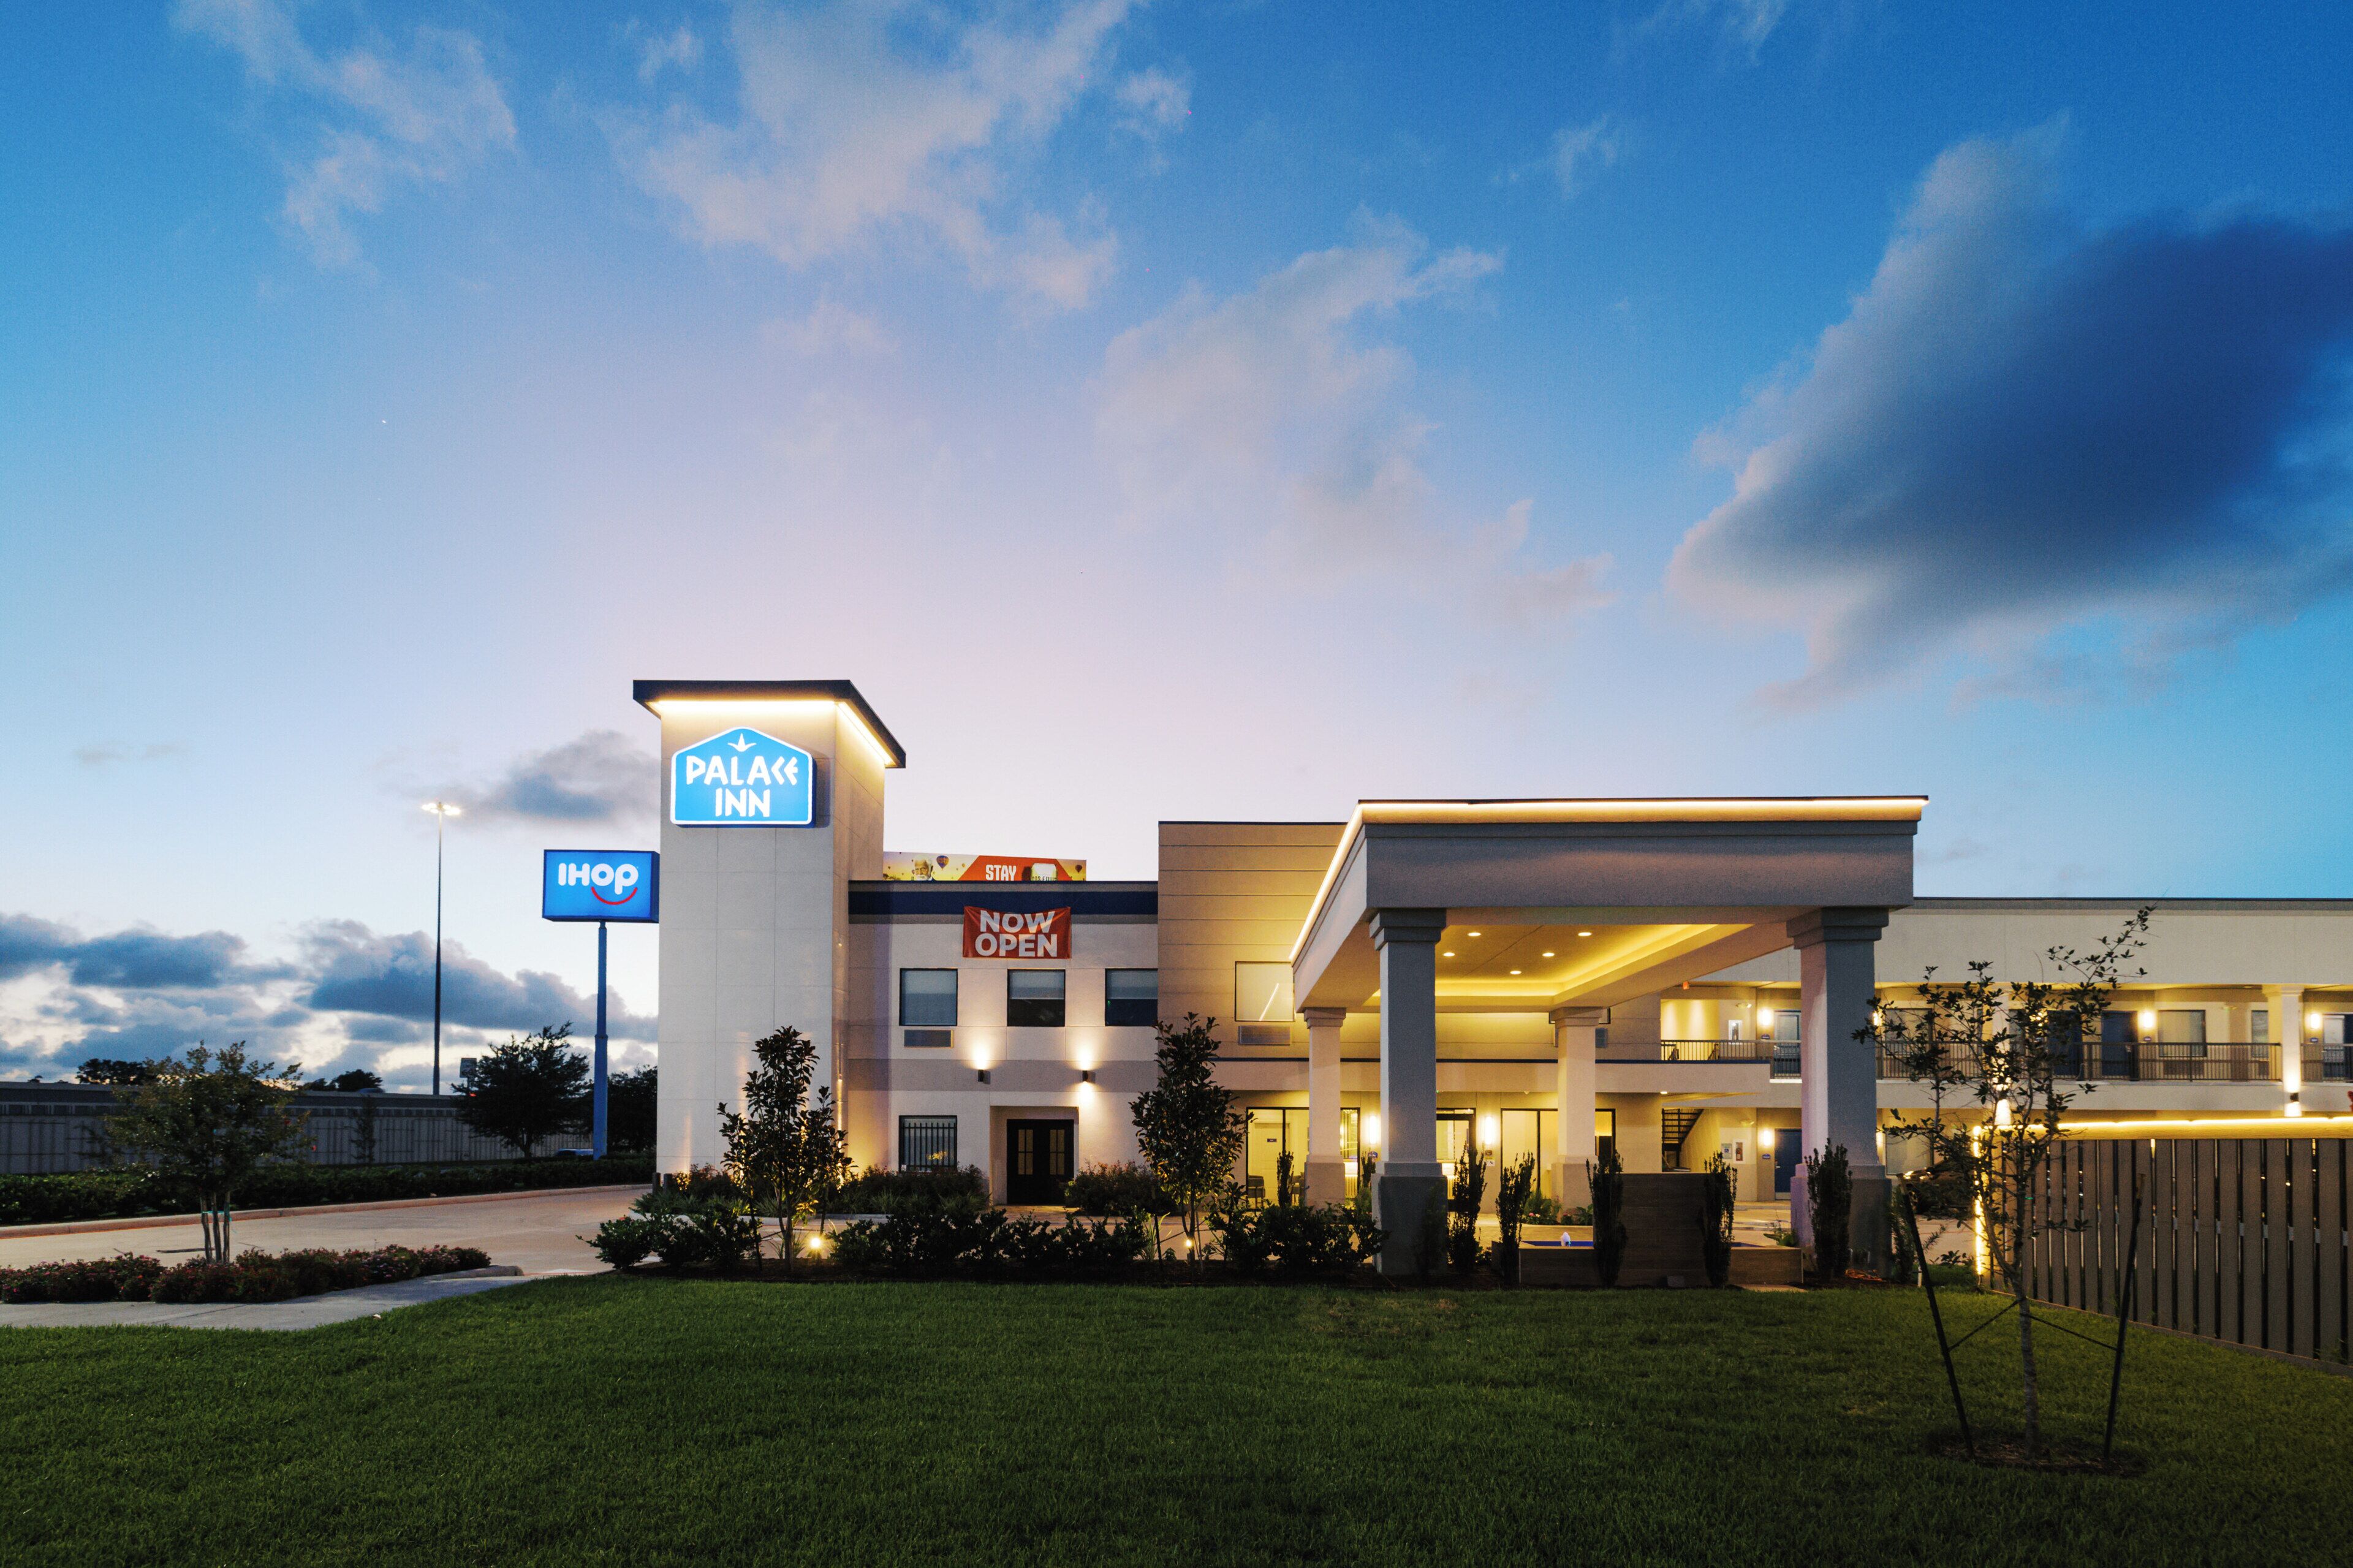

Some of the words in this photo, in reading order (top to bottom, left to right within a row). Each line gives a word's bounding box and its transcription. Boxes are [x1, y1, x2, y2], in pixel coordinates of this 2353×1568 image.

[686, 756, 798, 786] PALACE
[716, 787, 770, 817] INN
[985, 864, 1017, 881] STAY
[980, 910, 1055, 933] NOW
[975, 933, 1058, 957] OPEN
